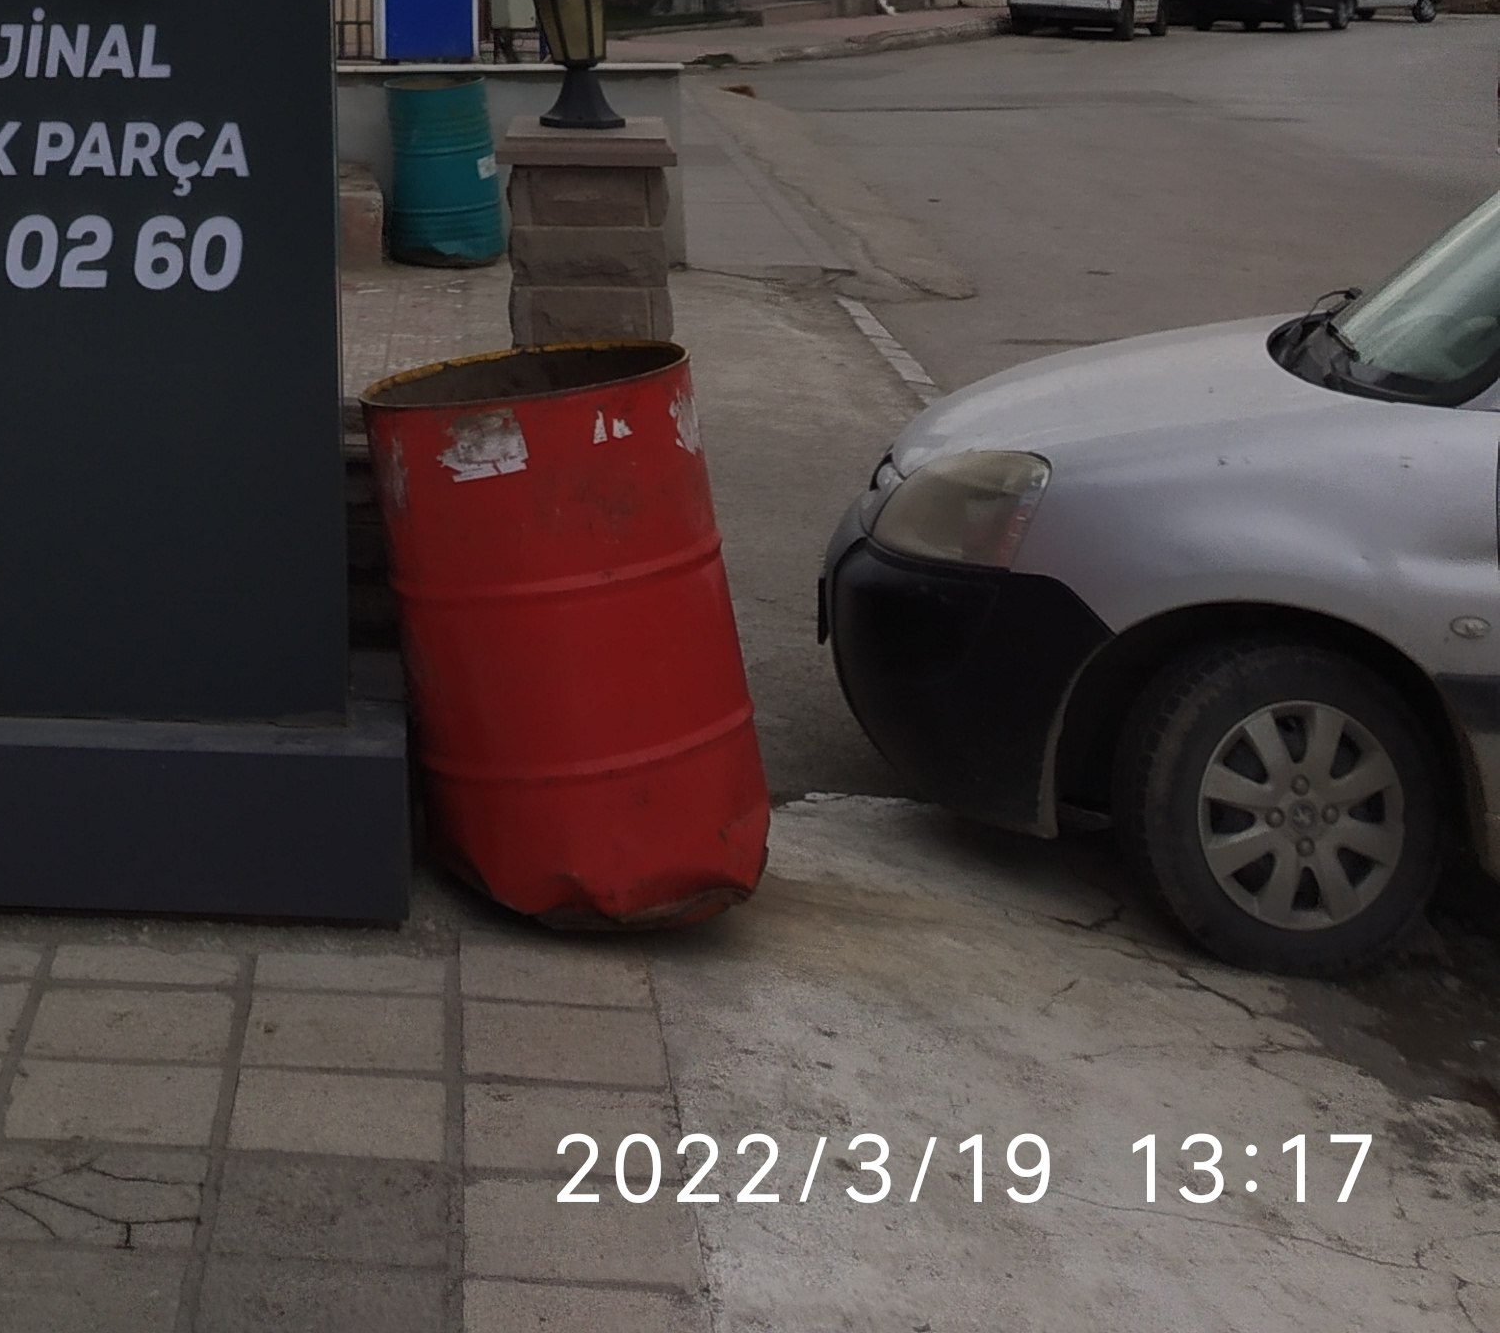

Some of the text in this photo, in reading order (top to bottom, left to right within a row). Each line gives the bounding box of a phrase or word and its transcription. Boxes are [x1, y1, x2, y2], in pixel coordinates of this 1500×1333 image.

[32, 120, 250, 197] PARÇA
[5, 213, 114, 290] 02
[133, 215, 244, 292] 60
